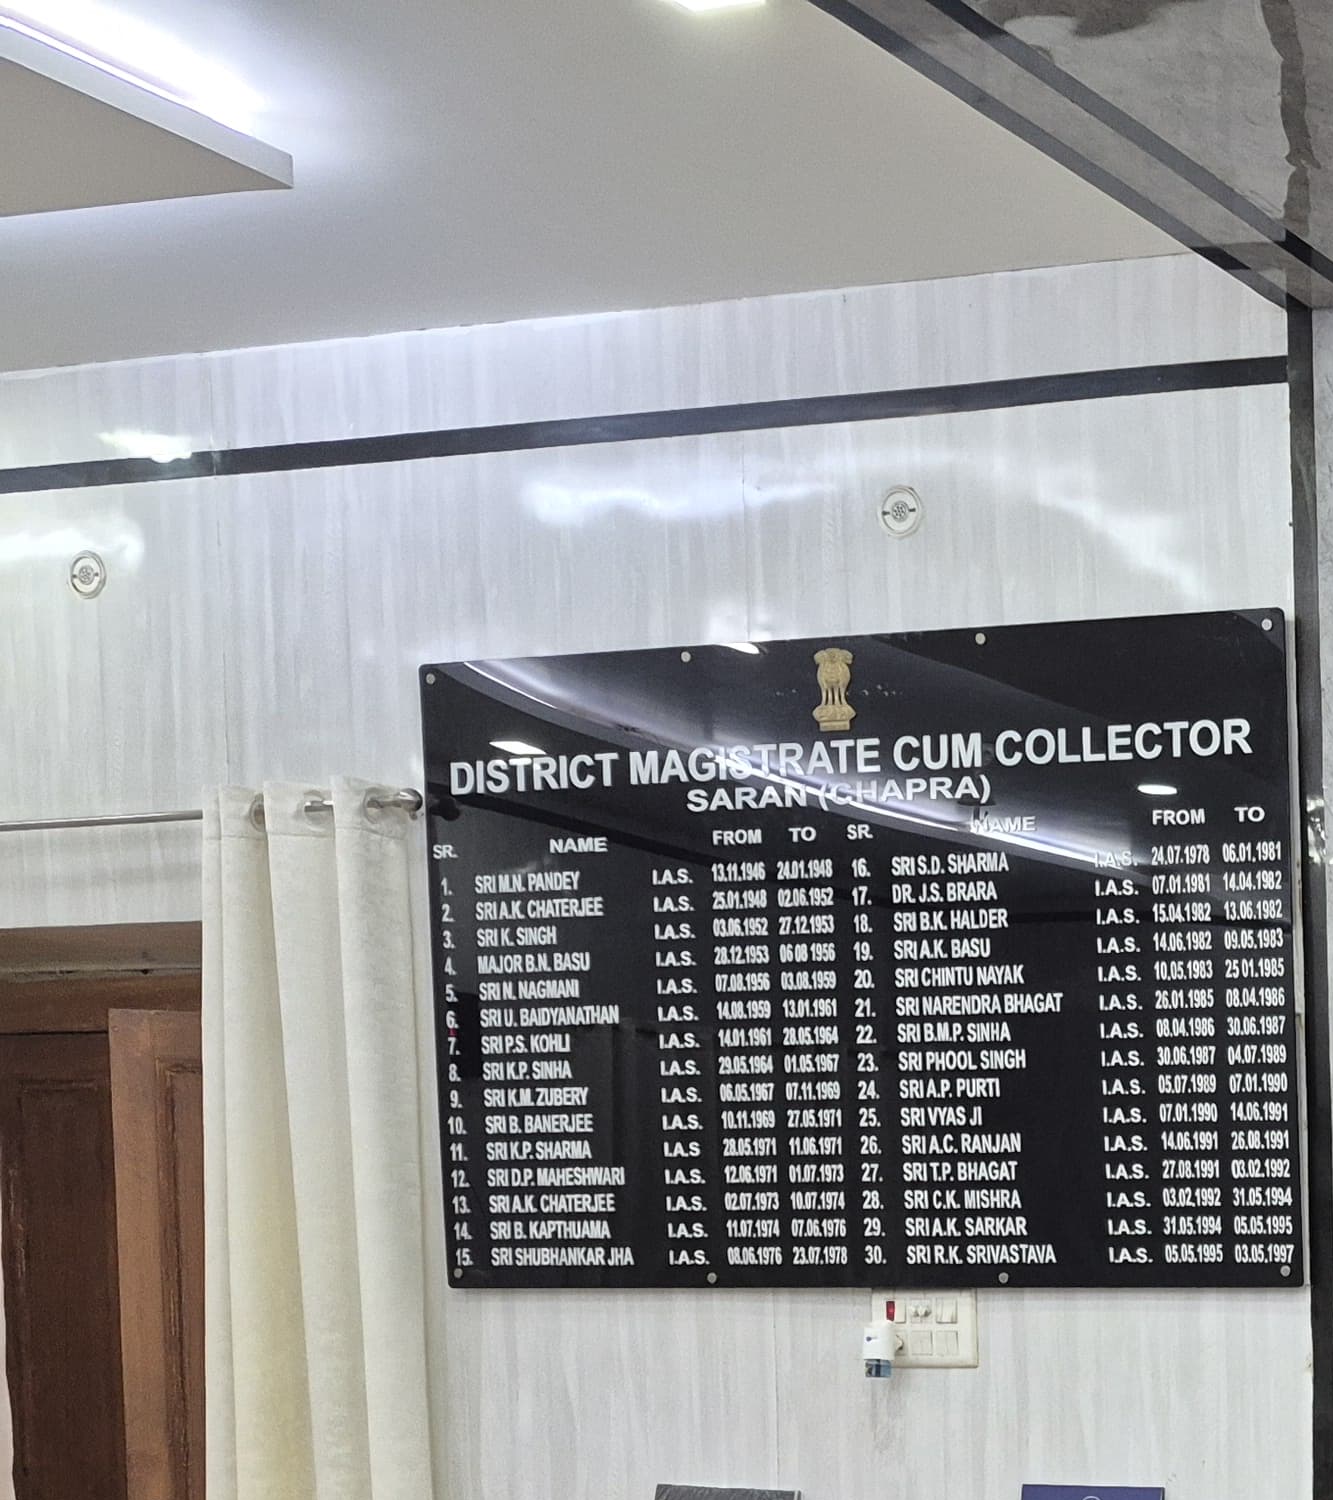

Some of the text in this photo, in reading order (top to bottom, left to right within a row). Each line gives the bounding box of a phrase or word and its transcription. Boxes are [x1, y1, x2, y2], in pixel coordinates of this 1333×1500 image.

[450, 718, 1252, 795] DISTRICT MAGISTRATE CUM COLLECTOR
[687, 774, 991, 812] SARAN (CHAPRA)
[433, 806, 1265, 860] SR. NAME FROM TO SR. NAME FROM TO
[442, 887, 834, 922] 2. SRI A.K. CHATERJEE I.A.S. 25.01.1948 02.06.1952
[854, 899, 1282, 933] 18. SRI B.K. HALDER I.A.S. 15.04.1982 13.06.1982
[446, 998, 836, 1029] 6. SRI U. BAIDYANATHAN I.A.S. 14.08.1959 13.01.1961
[449, 1054, 839, 1082] 8. SRI K.P. SINHA I.A.S. 29.05.1964 01.05.1967
[858, 1044, 1286, 1072] 23. SRI PHOOL SINGH I.A.S. 30.06.1987 04.07.1989
[451, 1164, 844, 1188] 12. SRI D.P. MAHESHWARI I.A.S. 12.06.1971 01.07.1973
[862, 1186, 1292, 1209] 28. SRI C.K. MISHRA I.A.S. 03.02.1992 31.05.1994
[865, 1243, 1294, 1264] 30. SRI R.K. SRIVASTAVA I.A.S. 05.05.1995 03.05.1997
